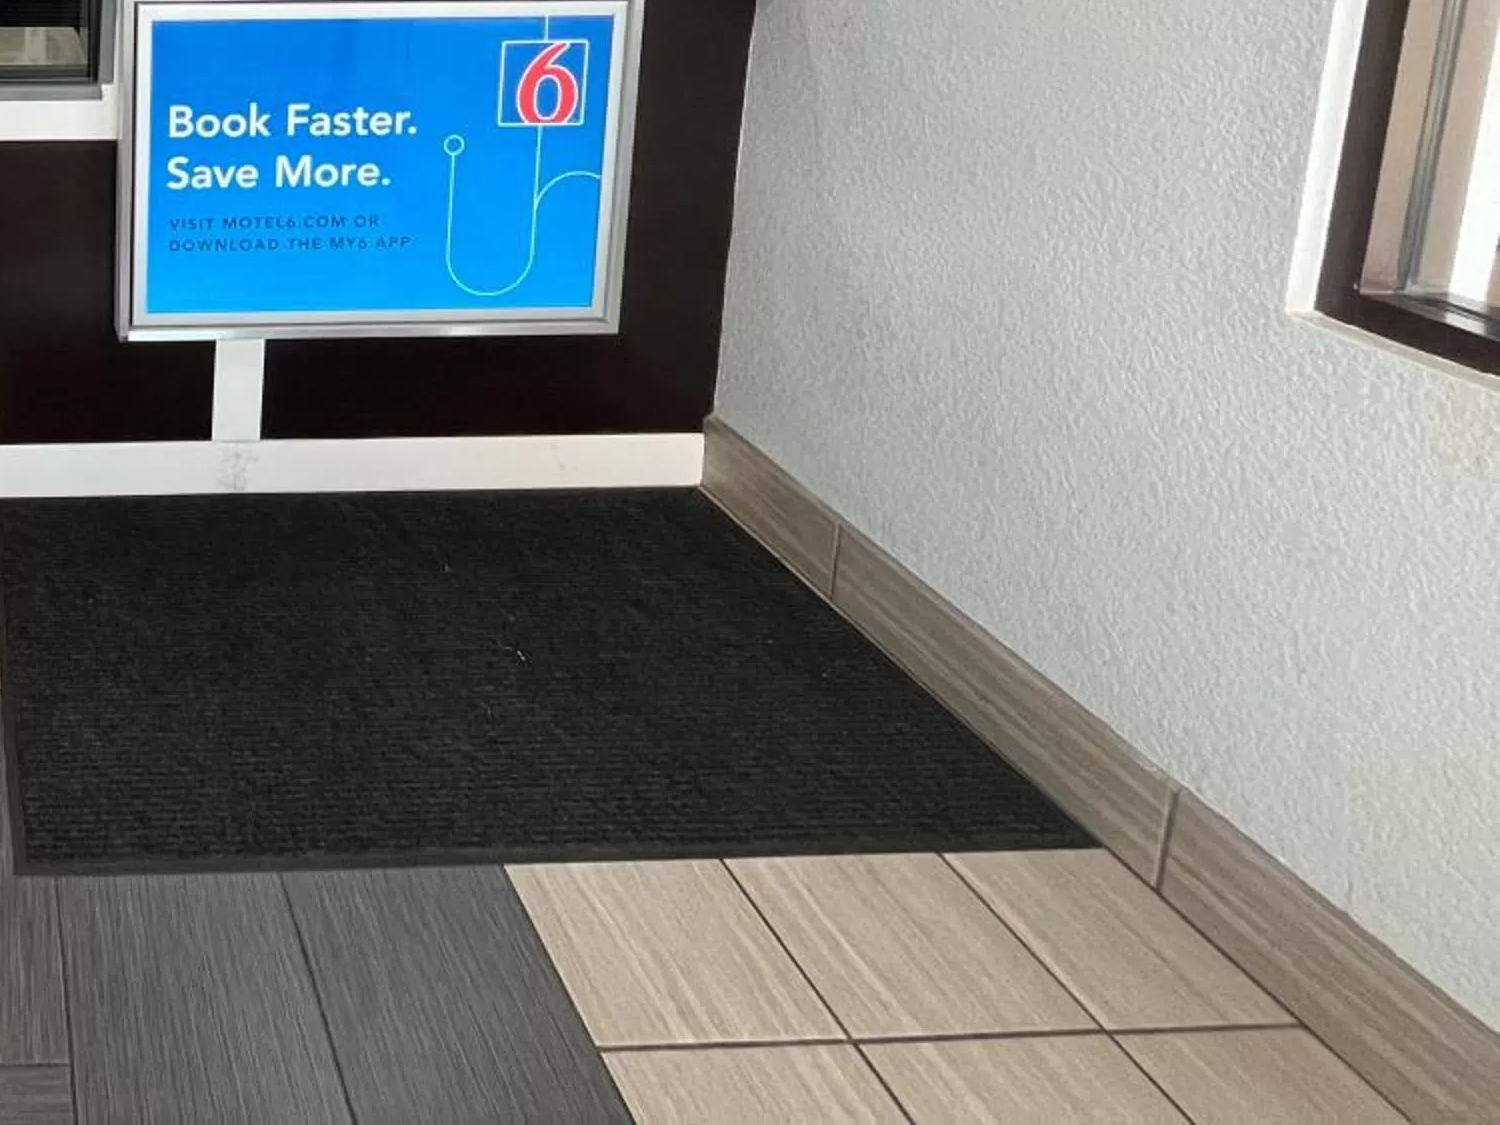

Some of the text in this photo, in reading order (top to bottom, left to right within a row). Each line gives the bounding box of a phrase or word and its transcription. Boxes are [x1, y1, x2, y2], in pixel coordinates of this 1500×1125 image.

[516, 41, 579, 125] 6
[168, 102, 417, 138] Book Faster.
[166, 154, 392, 190] Save More.
[169, 218, 215, 231] VISIT
[353, 214, 380, 229] OR
[169, 235, 413, 252] DOWNLOAD THE MY6 APP
